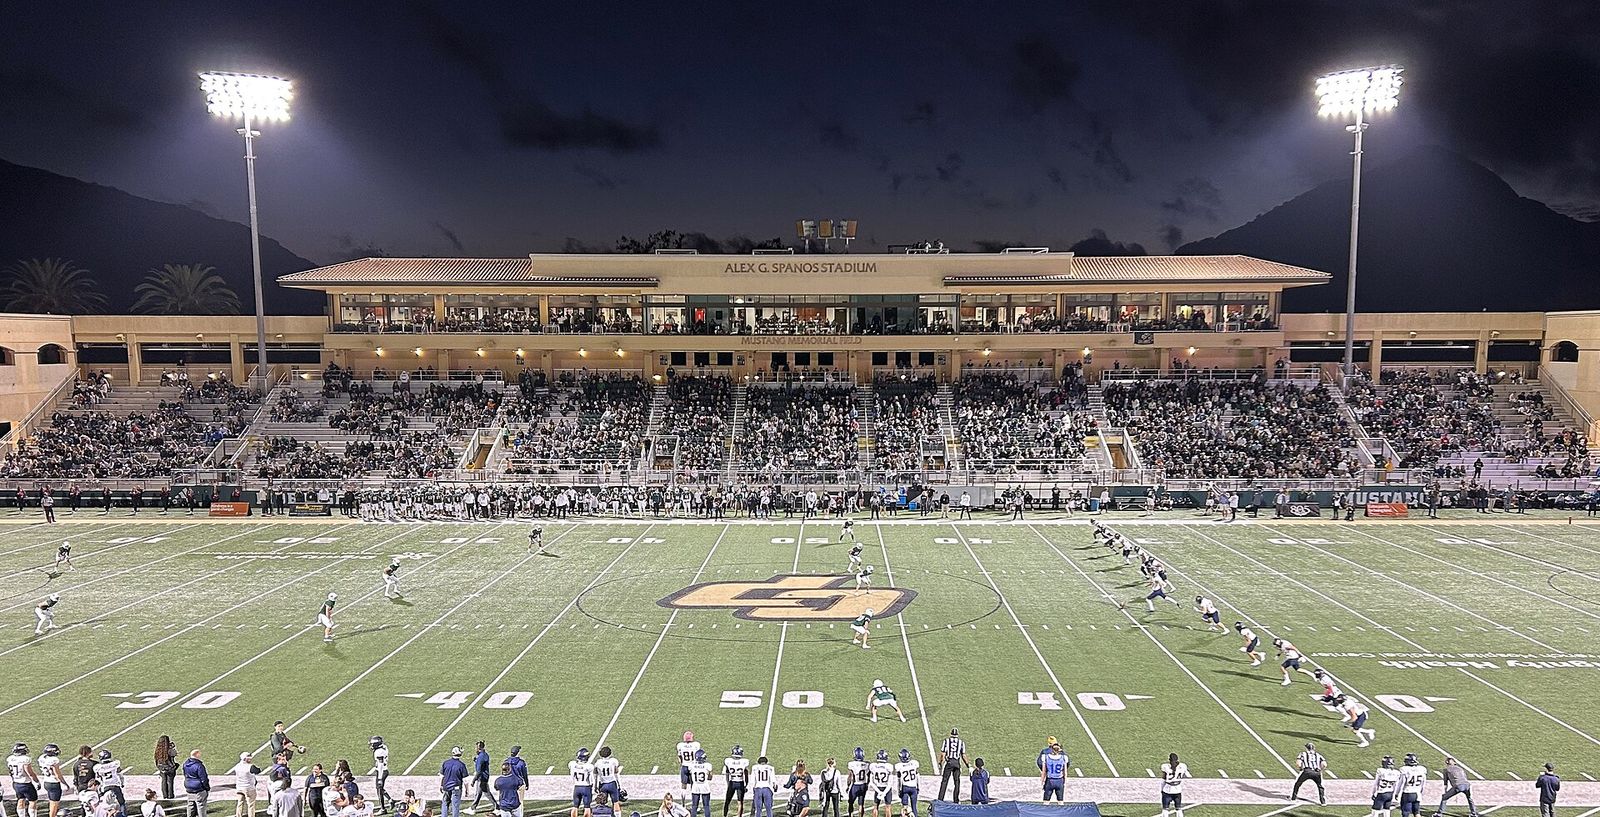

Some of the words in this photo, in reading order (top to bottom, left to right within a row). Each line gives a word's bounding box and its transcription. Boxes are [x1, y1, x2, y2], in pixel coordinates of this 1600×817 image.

[725, 263, 755, 273] ALEX
[758, 263, 769, 273] G.
[772, 263, 819, 273] SPANOS
[821, 263, 877, 273] STADIUM
[741, 337, 785, 345] MUSTANG
[787, 337, 838, 345] MEMORIAL
[840, 337, 862, 345] FIELD
[1290, 505, 1311, 516] 805
[1378, 660, 1500, 669] Health
[115, 691, 242, 709] 30
[424, 691, 535, 709] 40
[719, 690, 824, 708] 50
[1018, 691, 1127, 710] 40
[683, 751, 695, 761] 81
[602, 767, 610, 776] 11
[1049, 763, 1064, 774] 18
[694, 772, 706, 782] 13
[758, 770, 768, 781] 10
[874, 772, 887, 783] 42
[902, 769, 916, 782] 26
[1408, 775, 1422, 786] 45
